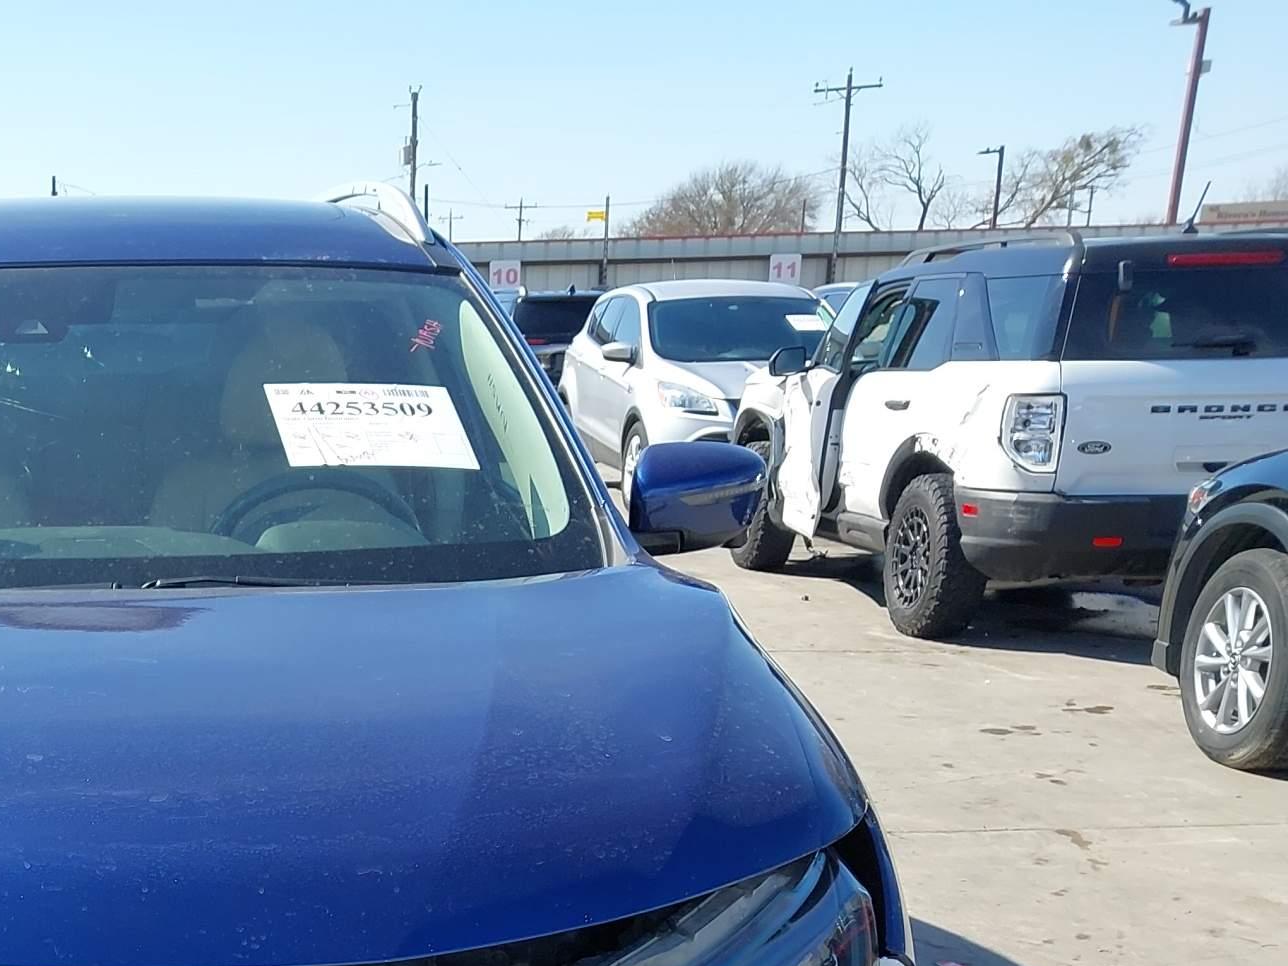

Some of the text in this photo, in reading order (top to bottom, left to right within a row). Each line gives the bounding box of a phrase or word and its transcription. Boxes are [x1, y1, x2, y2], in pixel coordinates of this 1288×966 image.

[493, 268, 518, 285] 10
[773, 261, 796, 278] 11
[291, 401, 433, 417] 44253509
